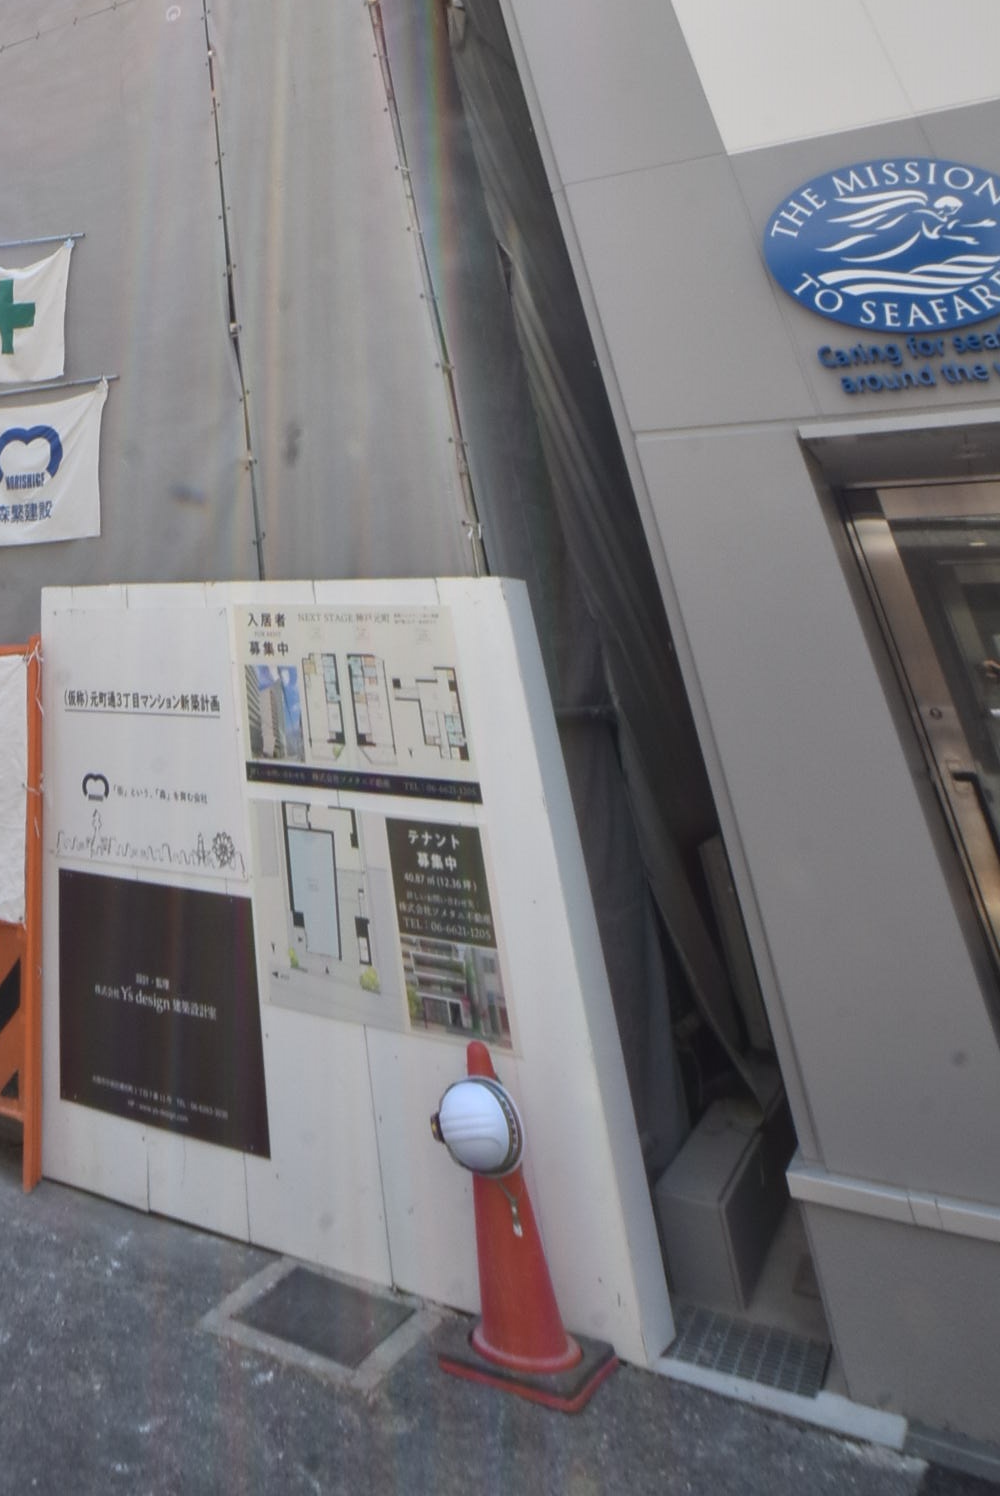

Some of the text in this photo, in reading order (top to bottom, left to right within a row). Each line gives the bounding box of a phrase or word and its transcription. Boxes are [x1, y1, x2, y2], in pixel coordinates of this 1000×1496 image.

[771, 161, 1000, 238] THE MISSION
[794, 273, 843, 312] TO
[817, 324, 1000, 368] Caring for sea
[840, 362, 937, 394] around
[941, 360, 989, 383] the
[408, 830, 459, 850] テナント
[417, 852, 457, 872] 募集中
[135, 989, 171, 1015] design
